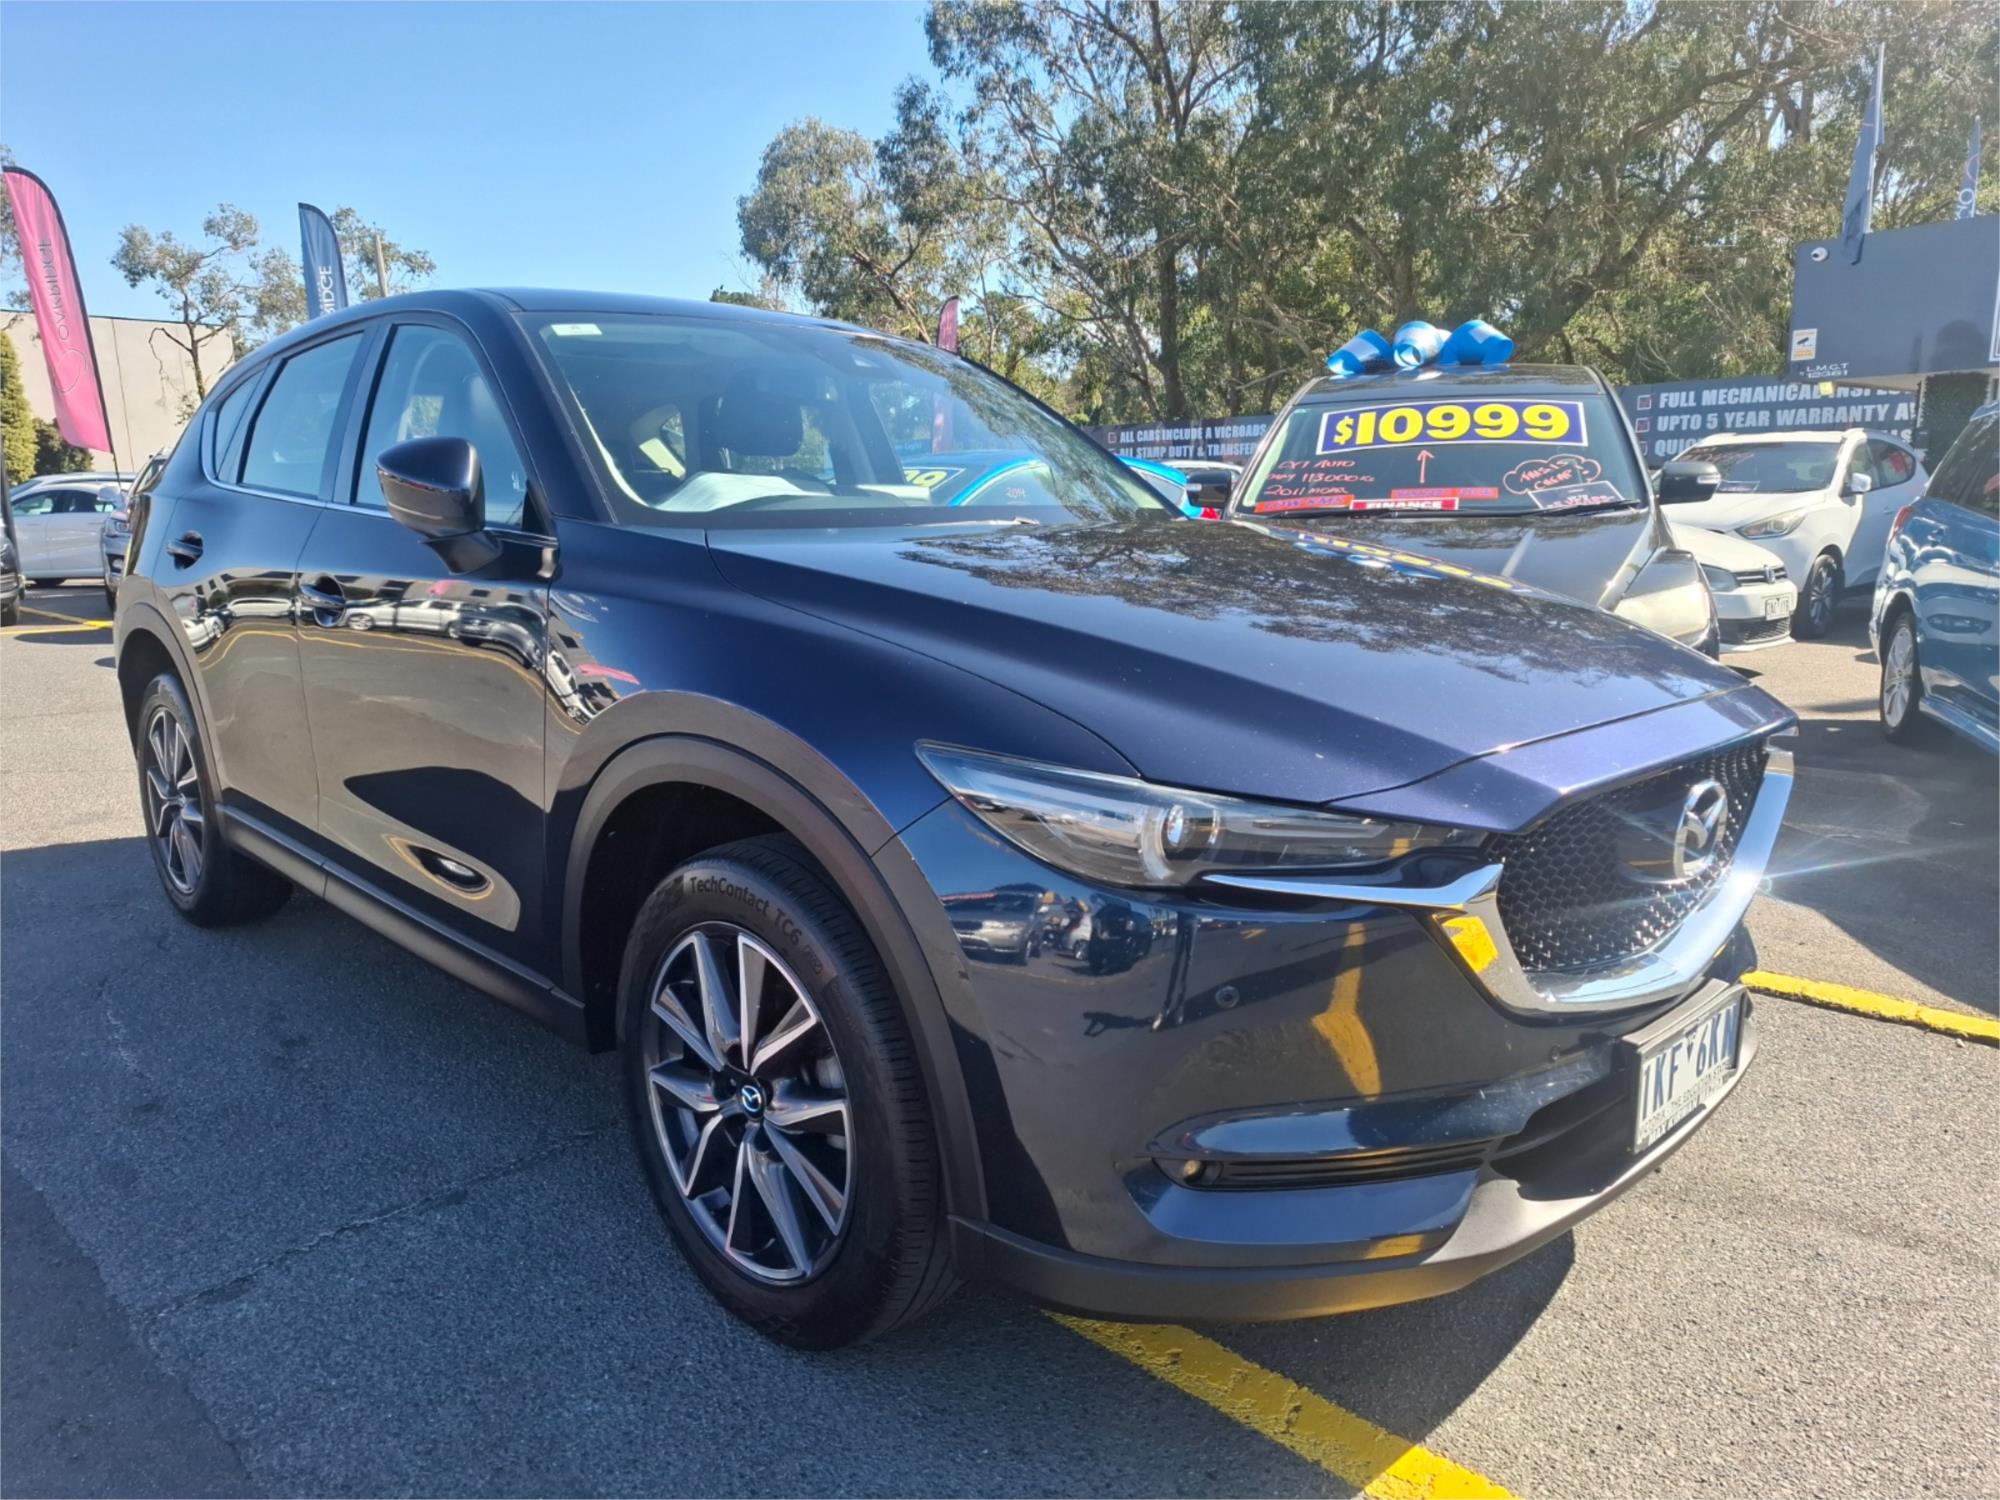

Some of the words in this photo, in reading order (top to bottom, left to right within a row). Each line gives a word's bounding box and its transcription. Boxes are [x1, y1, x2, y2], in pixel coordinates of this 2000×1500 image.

[1659, 392, 1696, 408] FULL
[1701, 384, 1820, 406] MECHANICAL
[1333, 403, 1569, 445] $10999
[1657, 414, 1701, 431] UPTO
[1706, 413, 1718, 429] 5
[1724, 411, 1769, 428] YEAR
[1776, 404, 1890, 426] WARRANTY
[1120, 431, 1135, 443] ALL
[1137, 430, 1161, 442] CARS
[1162, 428, 1203, 441] INCLUDE
[1205, 427, 1212, 438] A
[1213, 424, 1267, 438] VICROADS
[1135, 447, 1167, 459] STAMP
[1169, 445, 1195, 457] DUTY
[1197, 447, 1205, 457] &
[1366, 500, 1442, 510] FINANCE
[690, 876, 770, 918] TechContact
[774, 908, 802, 945] TC6
